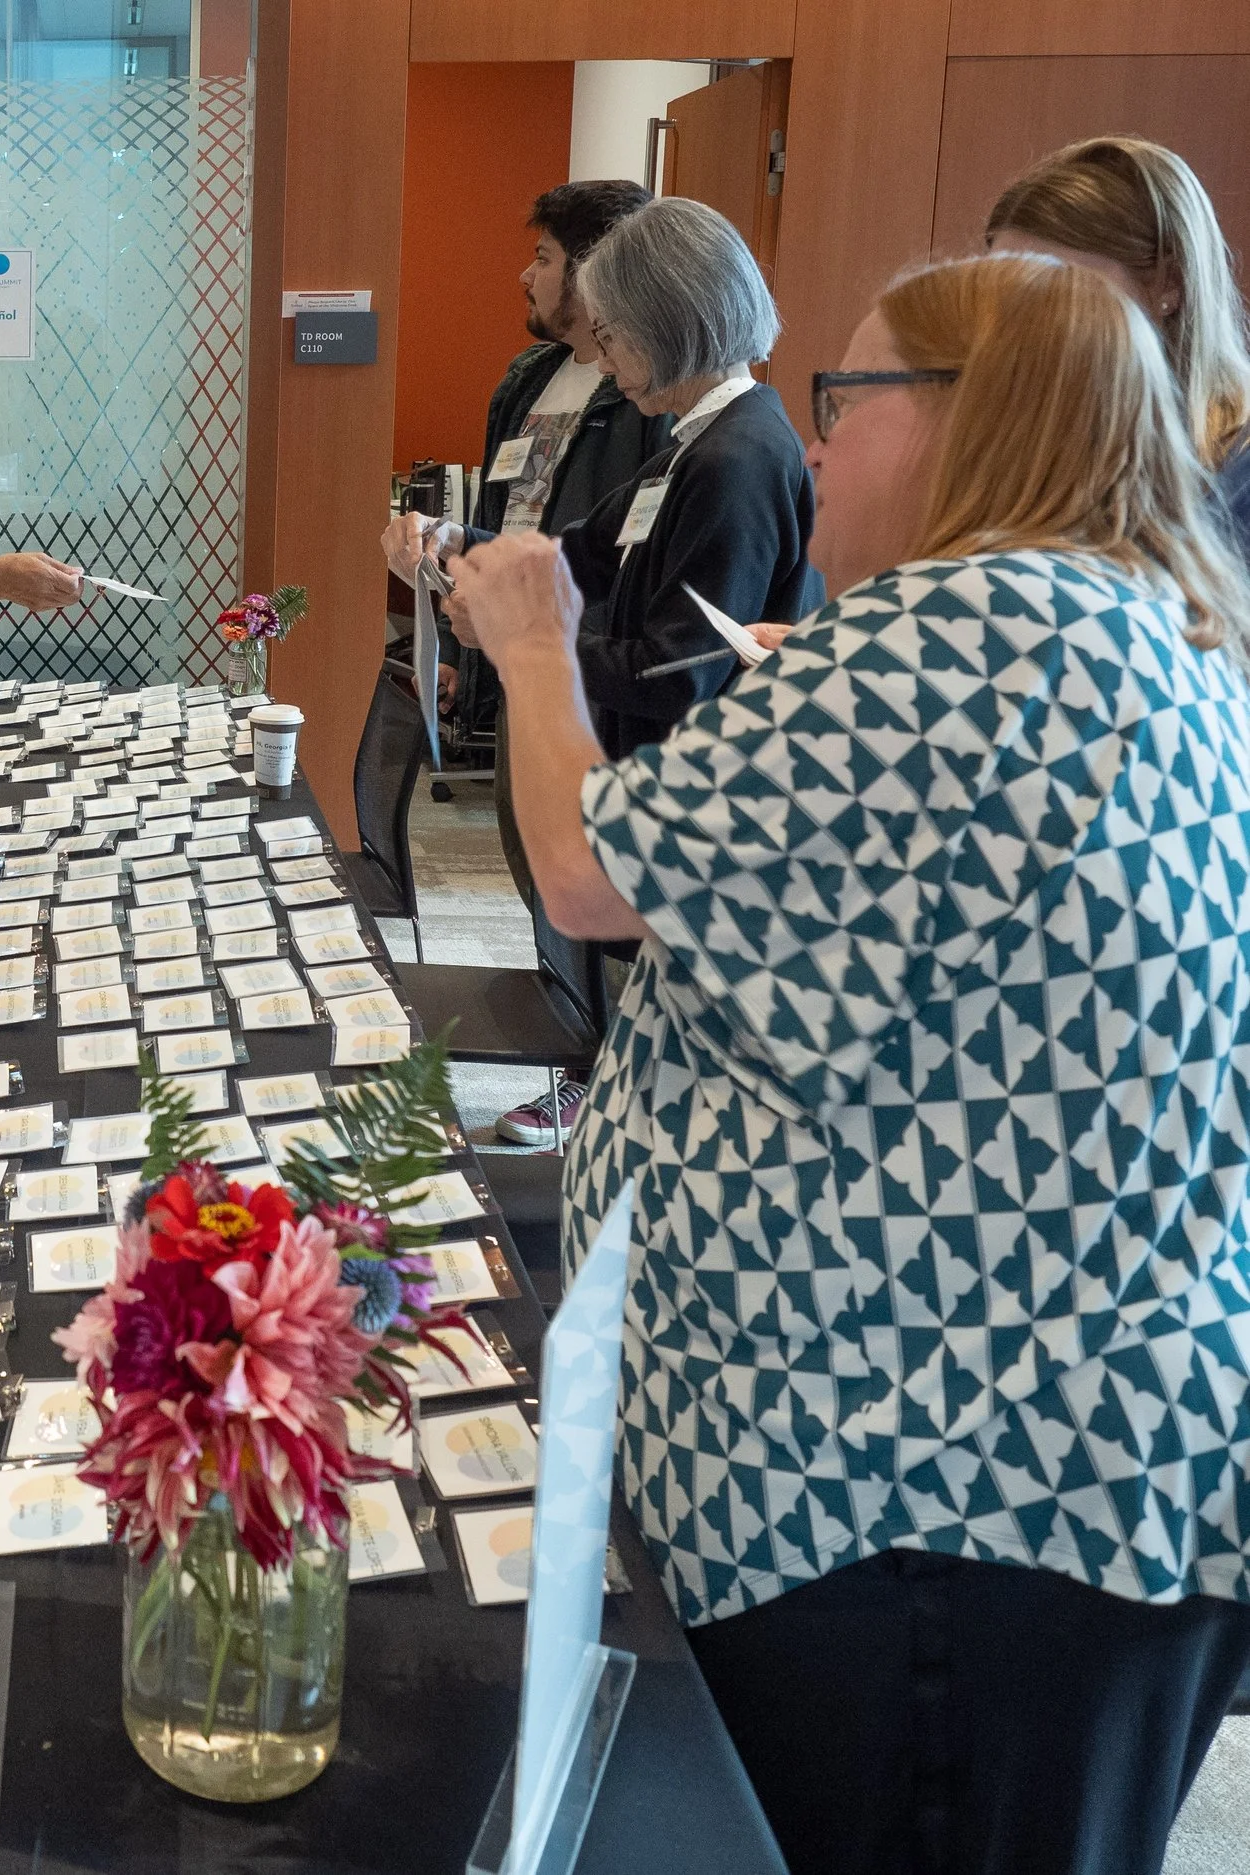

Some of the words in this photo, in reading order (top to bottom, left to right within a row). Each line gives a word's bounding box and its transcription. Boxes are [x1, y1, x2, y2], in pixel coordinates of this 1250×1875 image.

[301, 332, 313, 341] TD
[315, 332, 343, 341] ROOM
[300, 344, 323, 353] C110
[264, 743, 288, 751] Georgia
[478, 1415, 502, 1448] SIMONA
